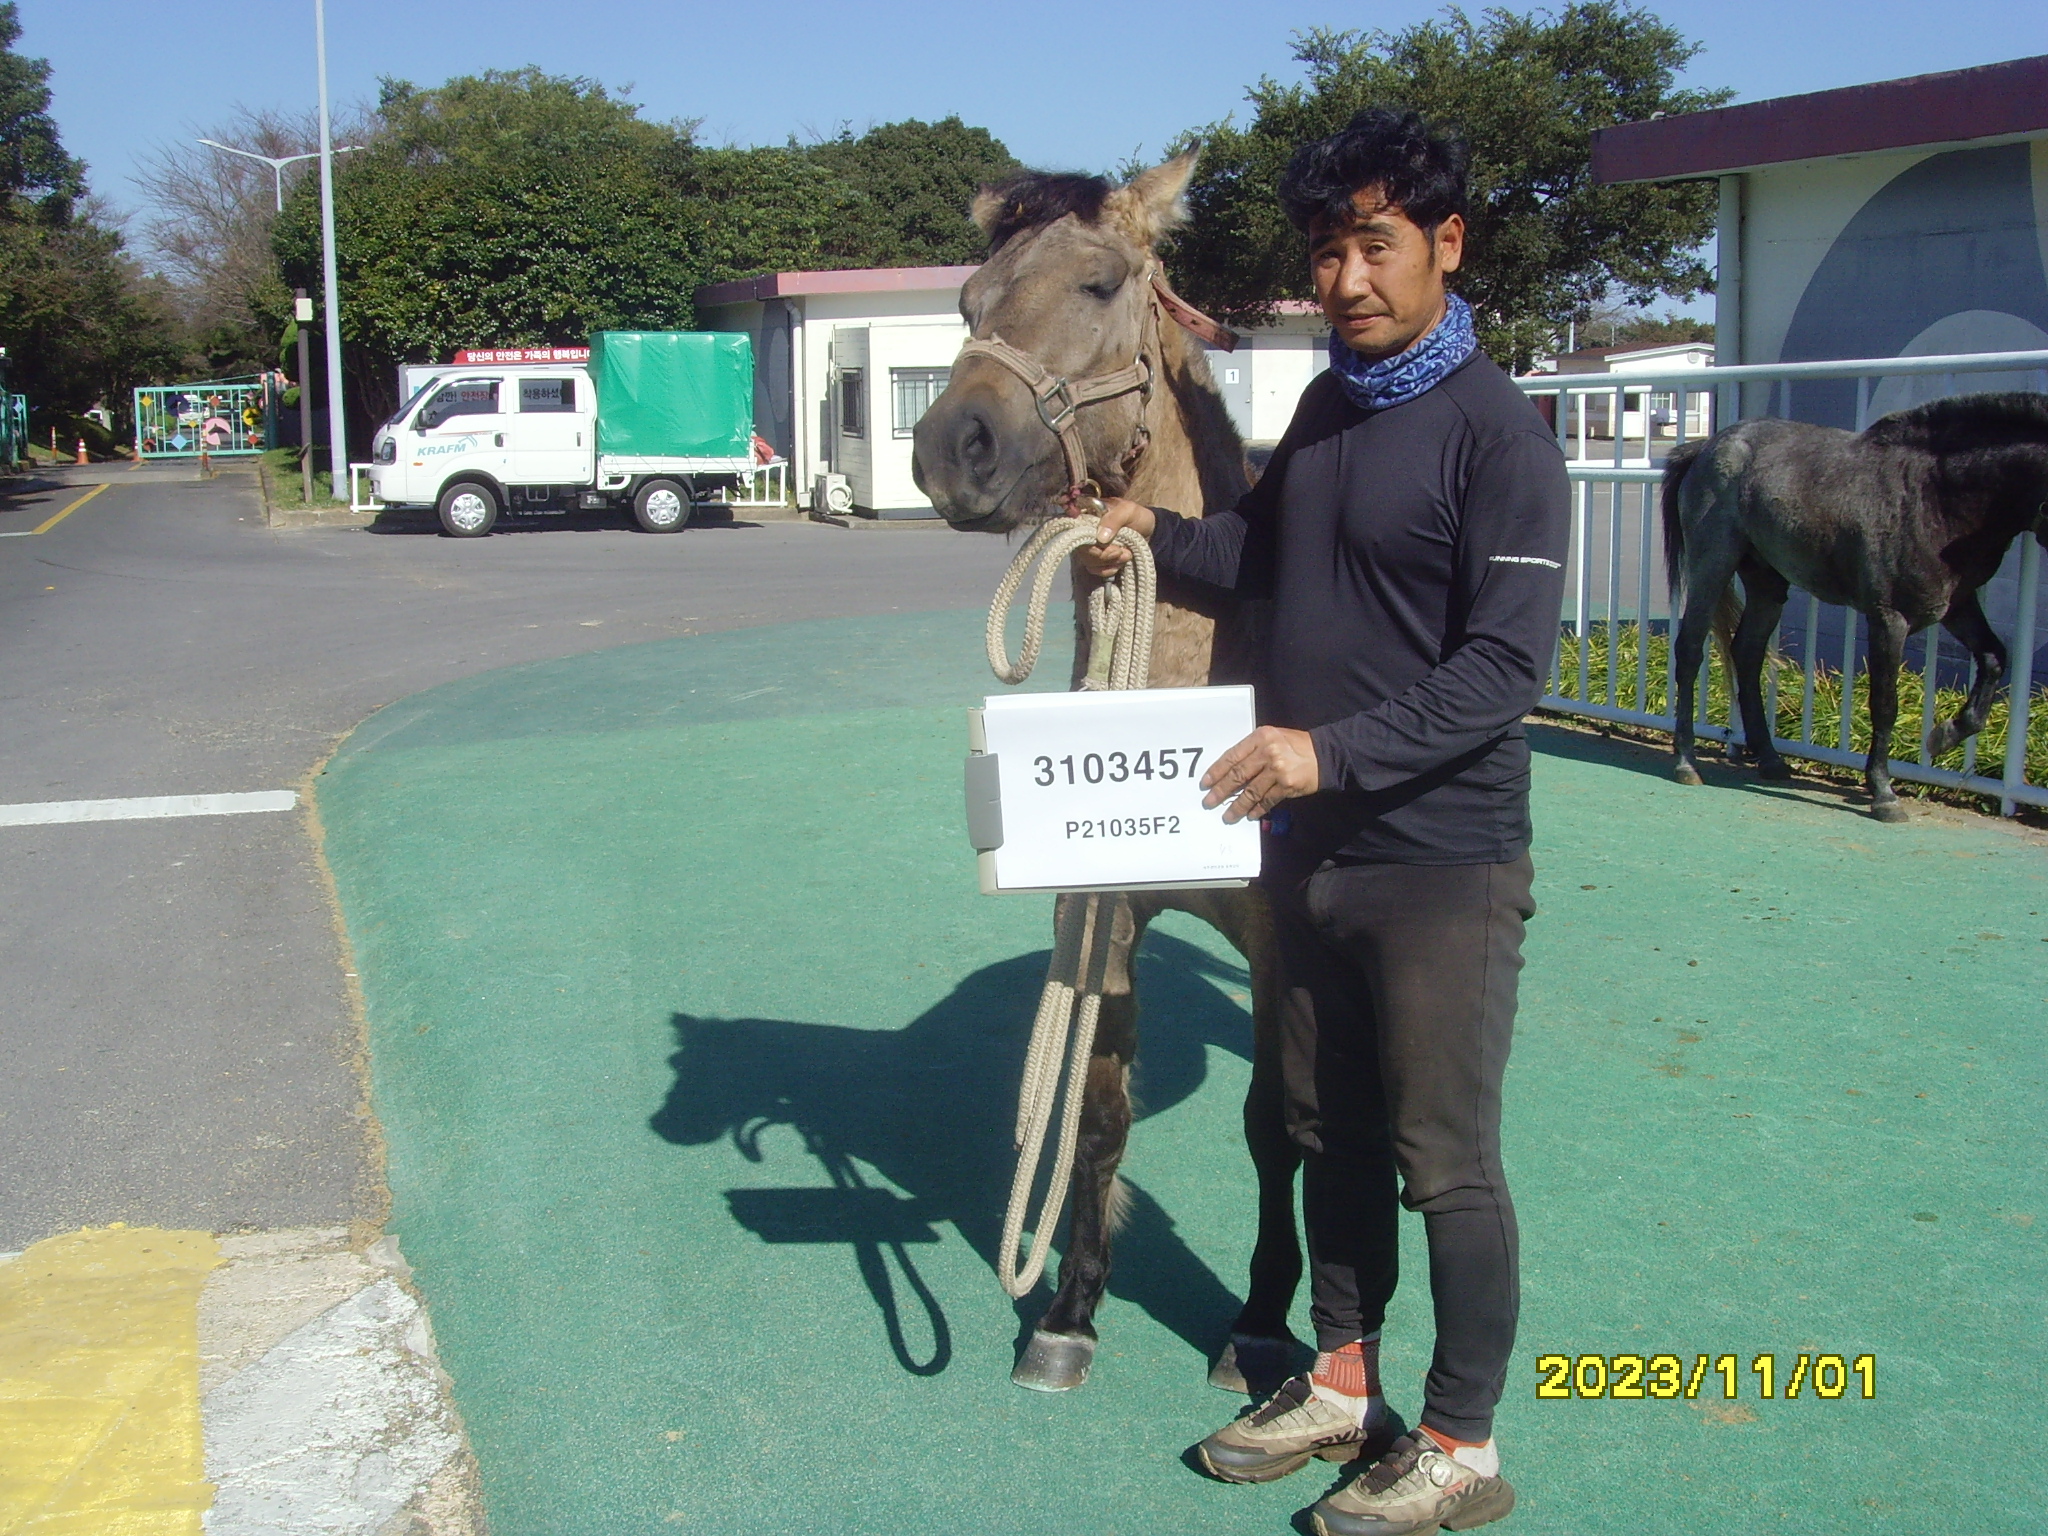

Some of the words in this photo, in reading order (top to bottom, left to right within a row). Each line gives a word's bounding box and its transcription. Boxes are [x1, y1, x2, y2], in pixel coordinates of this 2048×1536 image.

[467, 351, 493, 362] 당신의
[496, 351, 522, 361] 안전은
[524, 350, 551, 360] 가족의
[1230, 370, 1235, 381] 1
[417, 443, 467, 457] KRAFM
[1033, 746, 1204, 787] 3103457
[1065, 815, 1181, 840] P21035F2
